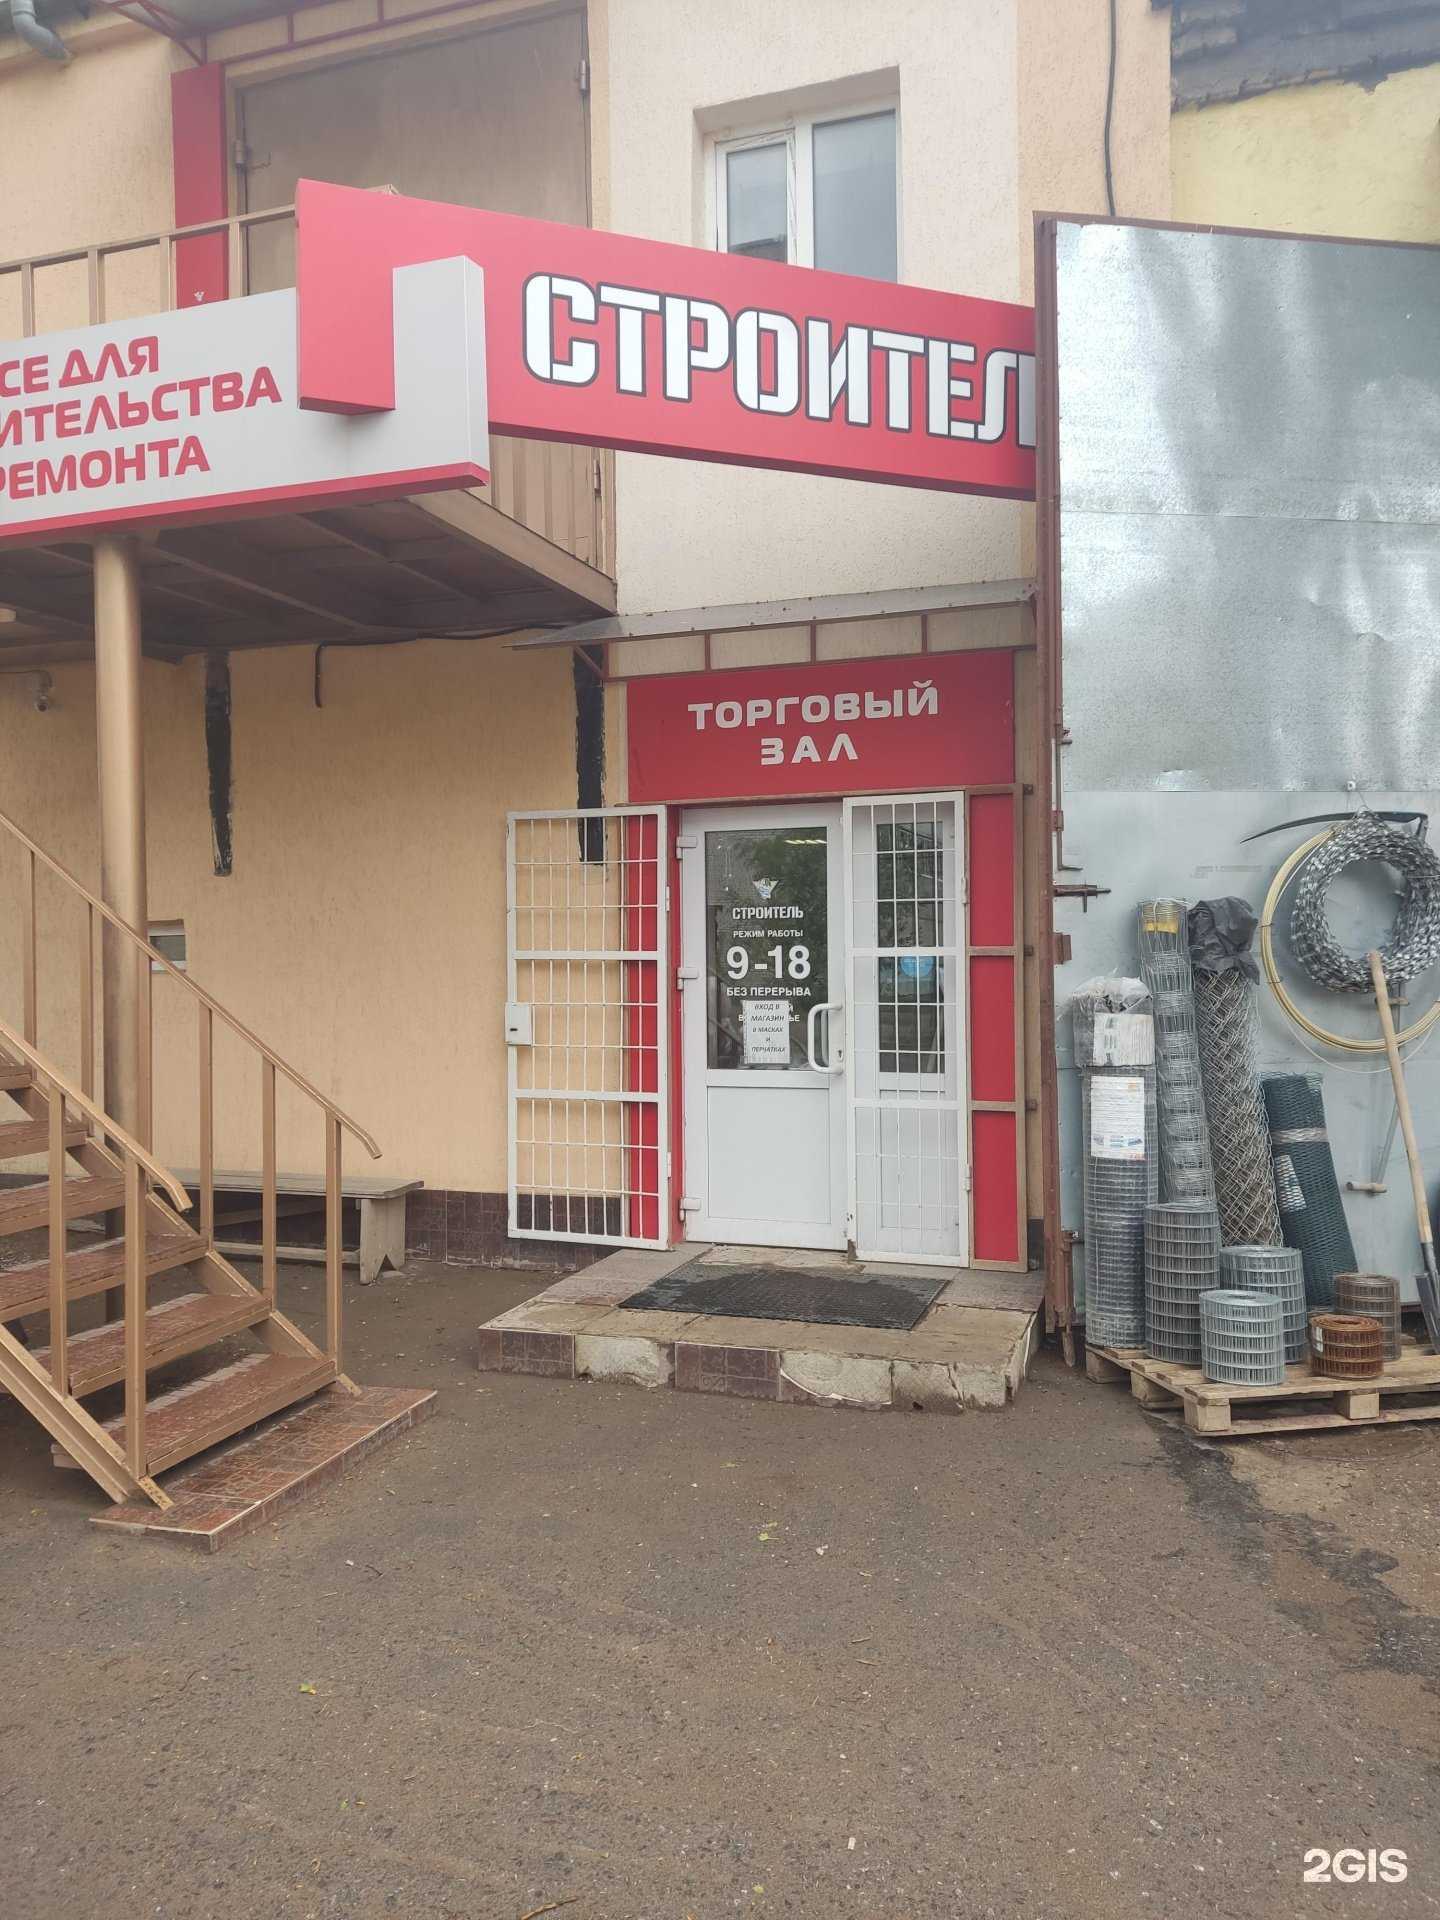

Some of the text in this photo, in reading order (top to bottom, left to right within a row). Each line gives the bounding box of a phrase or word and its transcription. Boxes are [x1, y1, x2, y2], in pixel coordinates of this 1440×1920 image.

[59, 335, 159, 388] ДЛЯ
[523, 271, 1036, 448] СТРОИТЕЛ
[0, 436, 210, 500] ЕМОНТА
[687, 679, 939, 730] ТОРГОВЫЙ
[760, 733, 859, 766] ЗАЛ
[732, 906, 804, 920] СТРОИТЕЛЬ
[733, 929, 803, 938] РЕЖИМ РАБОТЫ
[726, 945, 811, 980] 9-18
[726, 987, 811, 997] БЕЗ ПЕРЕРЫВА
